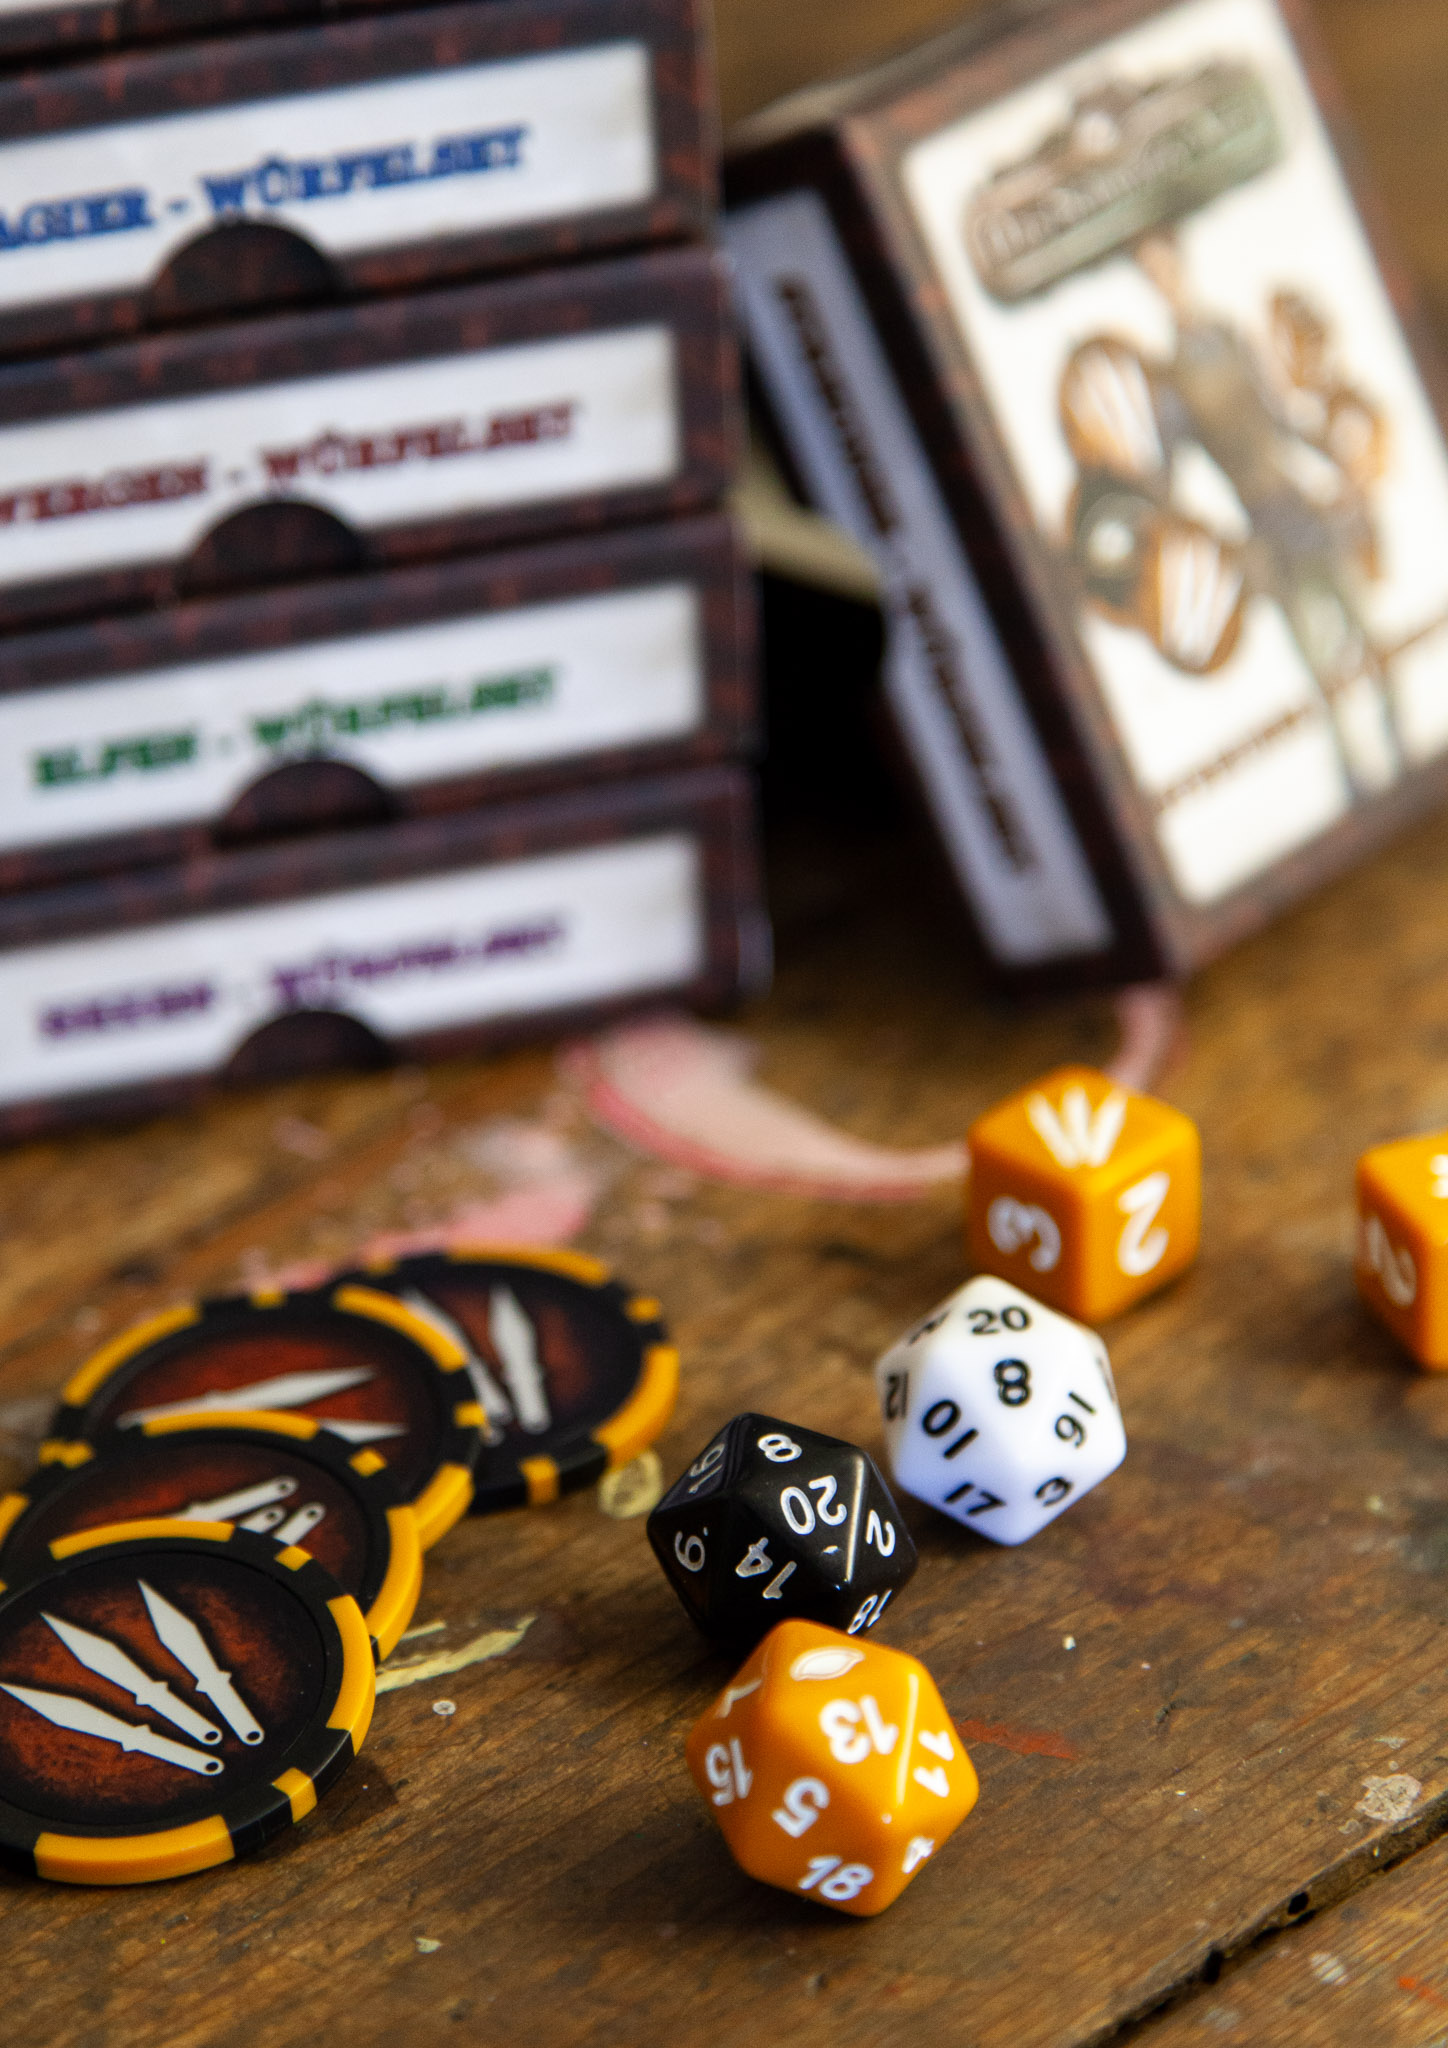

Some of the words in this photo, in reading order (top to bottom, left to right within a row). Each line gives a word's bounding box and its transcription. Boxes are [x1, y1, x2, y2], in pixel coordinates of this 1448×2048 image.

[1116, 1169, 1171, 1277] 2
[967, 1305, 1032, 1337] 20
[993, 1358, 1032, 1407] 8
[757, 1433, 803, 1463] 8
[921, 1399, 980, 1460] 10
[779, 1474, 848, 1535] 20
[943, 1481, 1007, 1517] 17
[865, 1509, 896, 1557] 2
[735, 1537, 798, 1600] 14
[819, 1694, 899, 1765] 13
[705, 1736, 753, 1807] 15
[912, 1729, 955, 1798] 11
[771, 1775, 831, 1839] 5
[799, 1854, 875, 1902] 18
